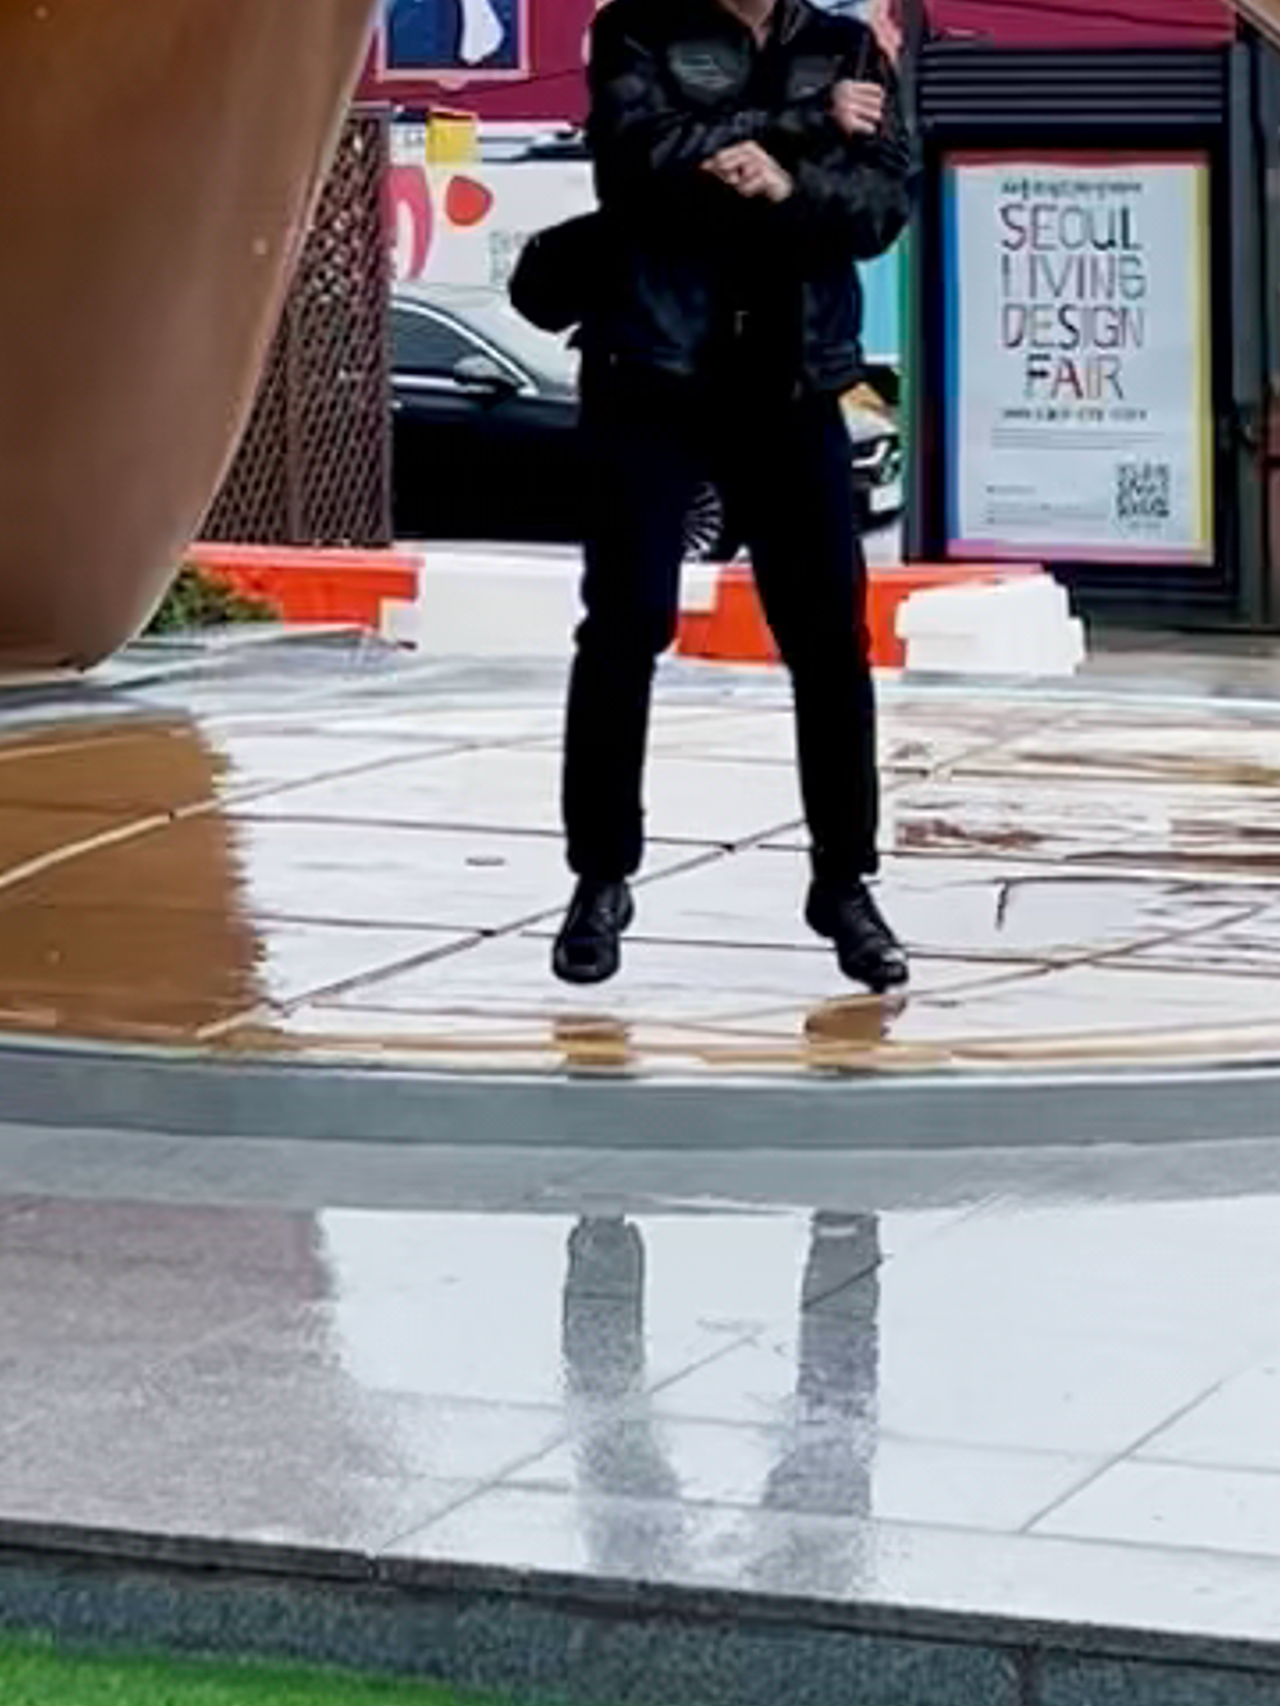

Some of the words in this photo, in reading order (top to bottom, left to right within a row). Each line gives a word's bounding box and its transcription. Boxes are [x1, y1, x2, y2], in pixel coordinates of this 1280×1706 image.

[999, 203, 1144, 251] SEOUL
[1001, 254, 1146, 300] LIVING
[1001, 303, 1144, 350] DESIGN
[1024, 353, 1124, 400] FAIR
